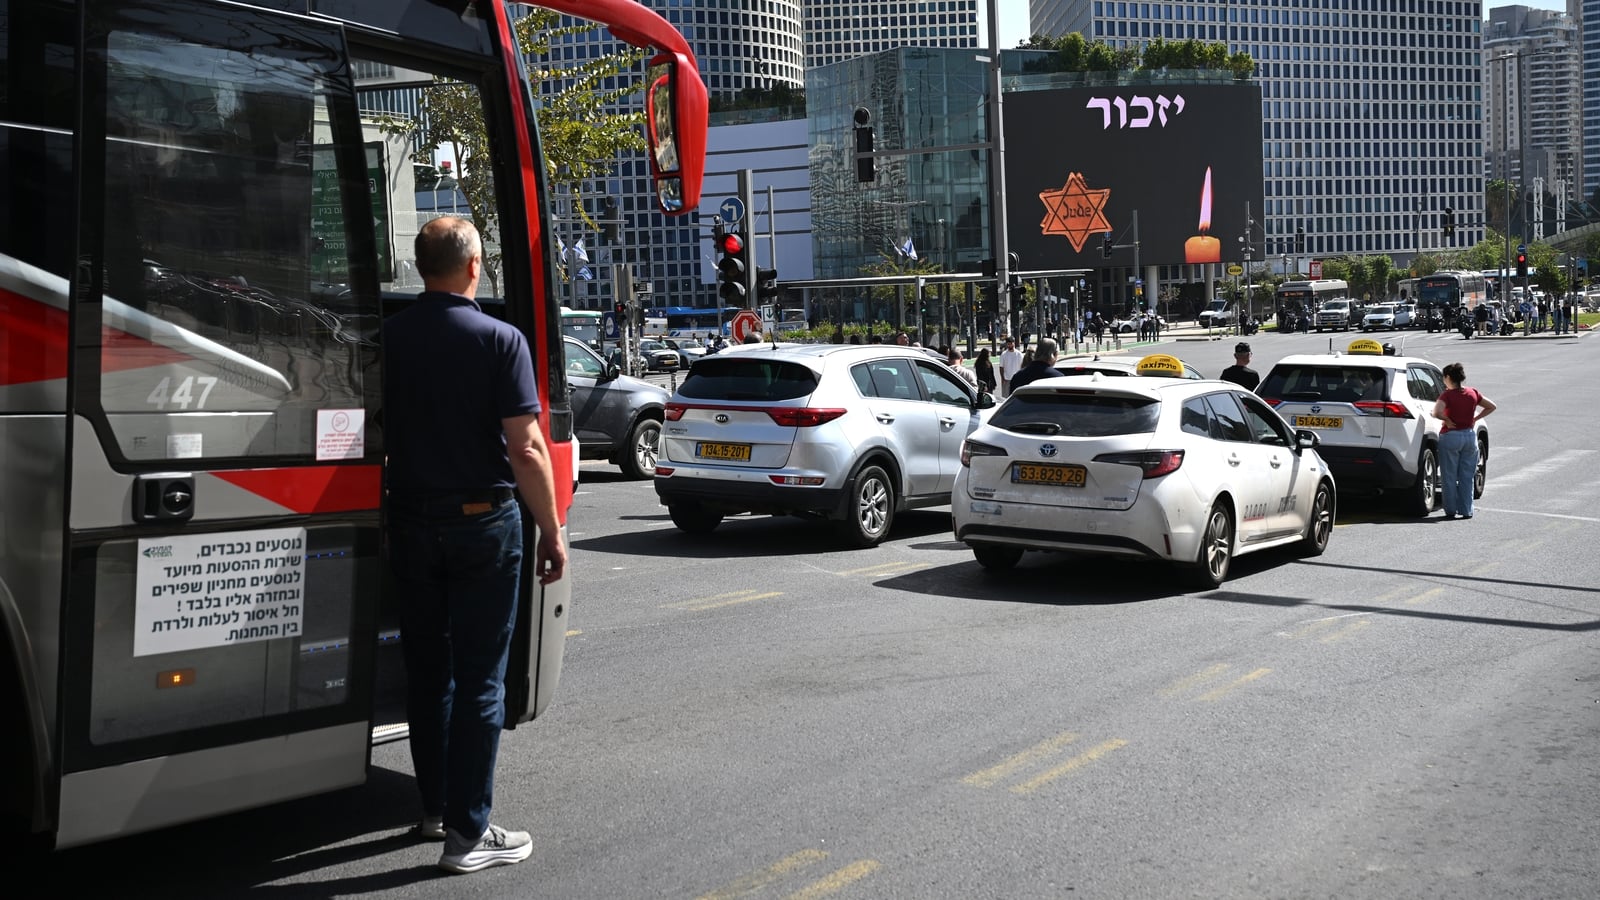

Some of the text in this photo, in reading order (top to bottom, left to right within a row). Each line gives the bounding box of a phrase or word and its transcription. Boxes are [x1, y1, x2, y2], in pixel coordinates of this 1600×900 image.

[1086, 94, 1185, 130] יזכור
[317, 171, 337, 179] ריאלי
[1063, 201, 1091, 220] Jude
[147, 376, 217, 409] 447
[196, 538, 302, 559] נוסעים נכבדים,
[163, 555, 301, 578] שירות ההסעות מיועד
[152, 570, 300, 597] לנוסעים מחניון שפירים
[186, 596, 221, 611] בלבד
[225, 593, 252, 607] אליו
[255, 589, 300, 604] ובחזרה
[151, 604, 299, 633] חל איסור לעלות ולרדת
[225, 622, 298, 641] בין התחנות.
